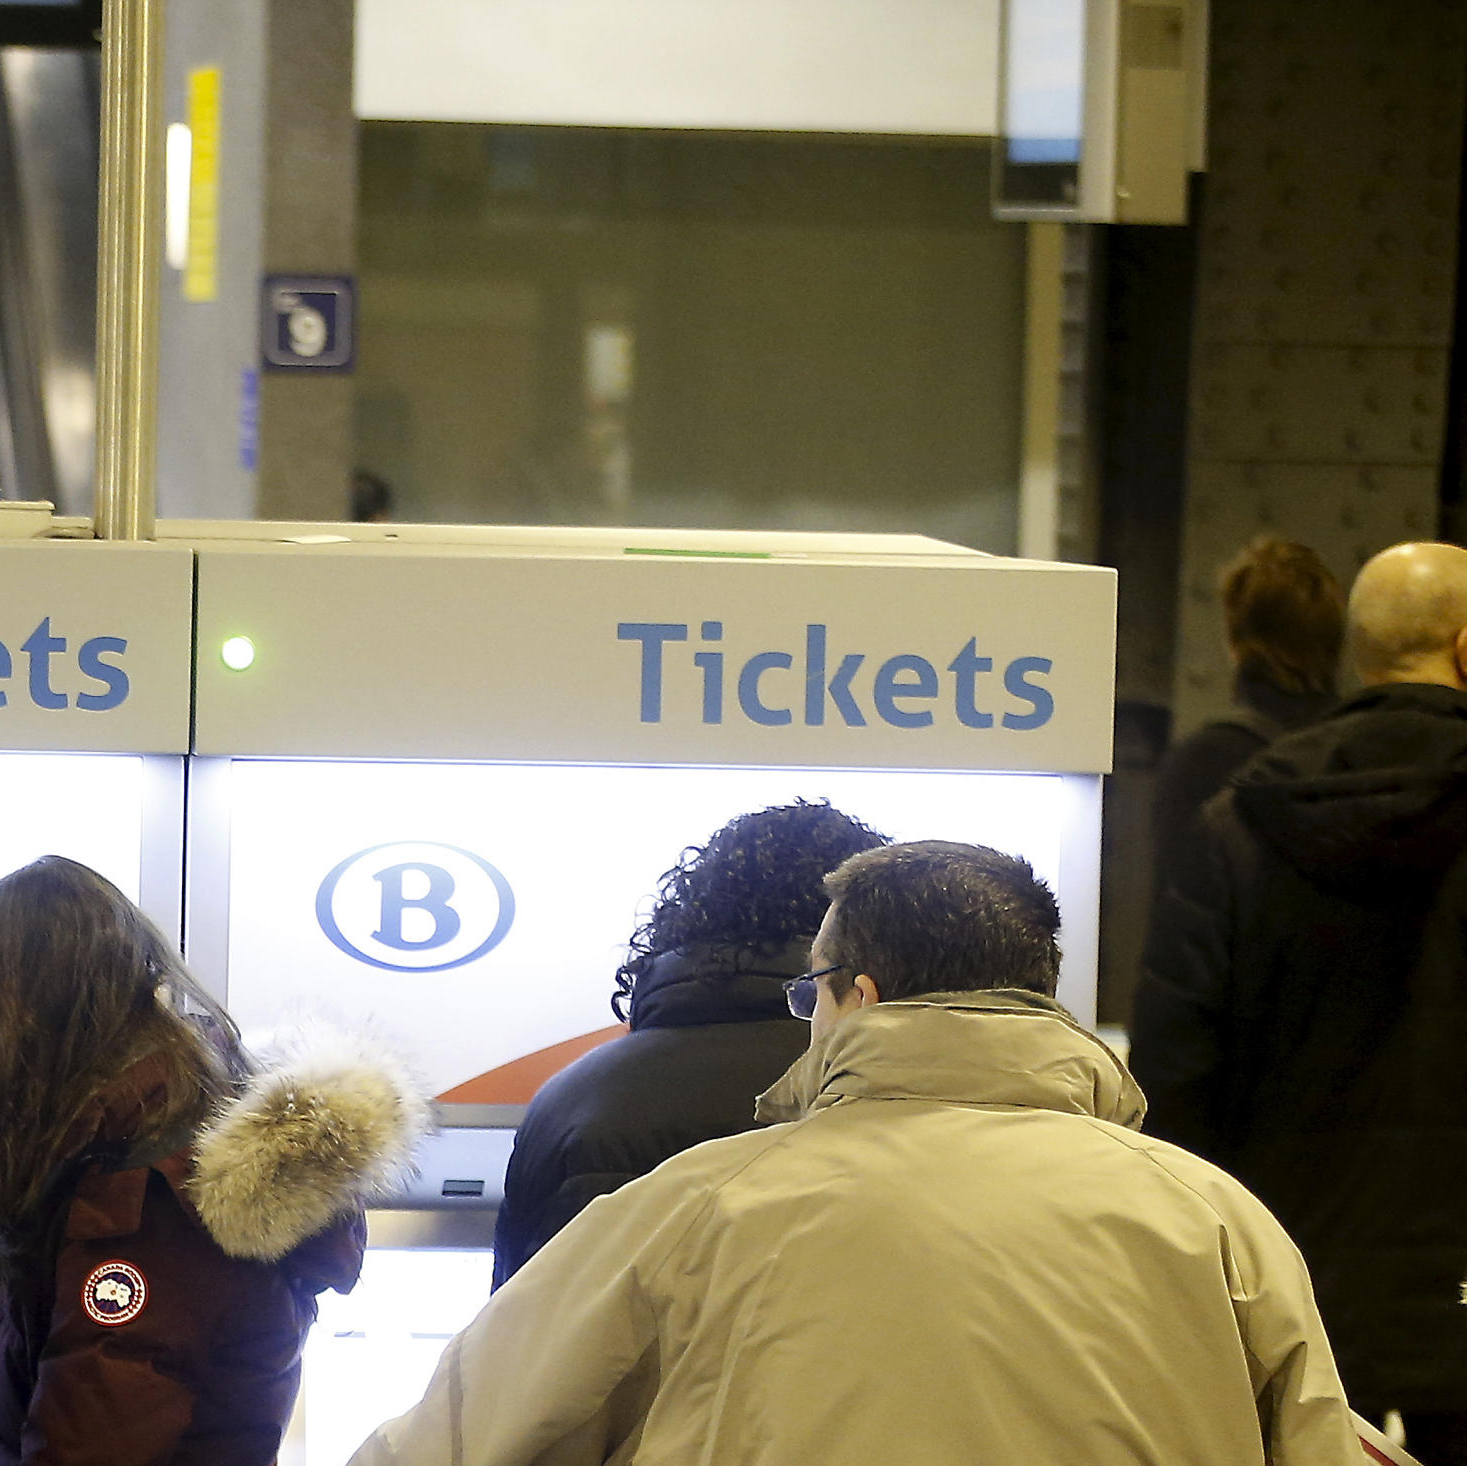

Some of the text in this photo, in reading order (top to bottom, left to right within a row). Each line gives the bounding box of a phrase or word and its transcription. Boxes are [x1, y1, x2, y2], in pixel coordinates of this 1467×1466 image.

[288, 307, 328, 357] 9
[616, 619, 1055, 731] Tickets
[370, 861, 461, 952] B
